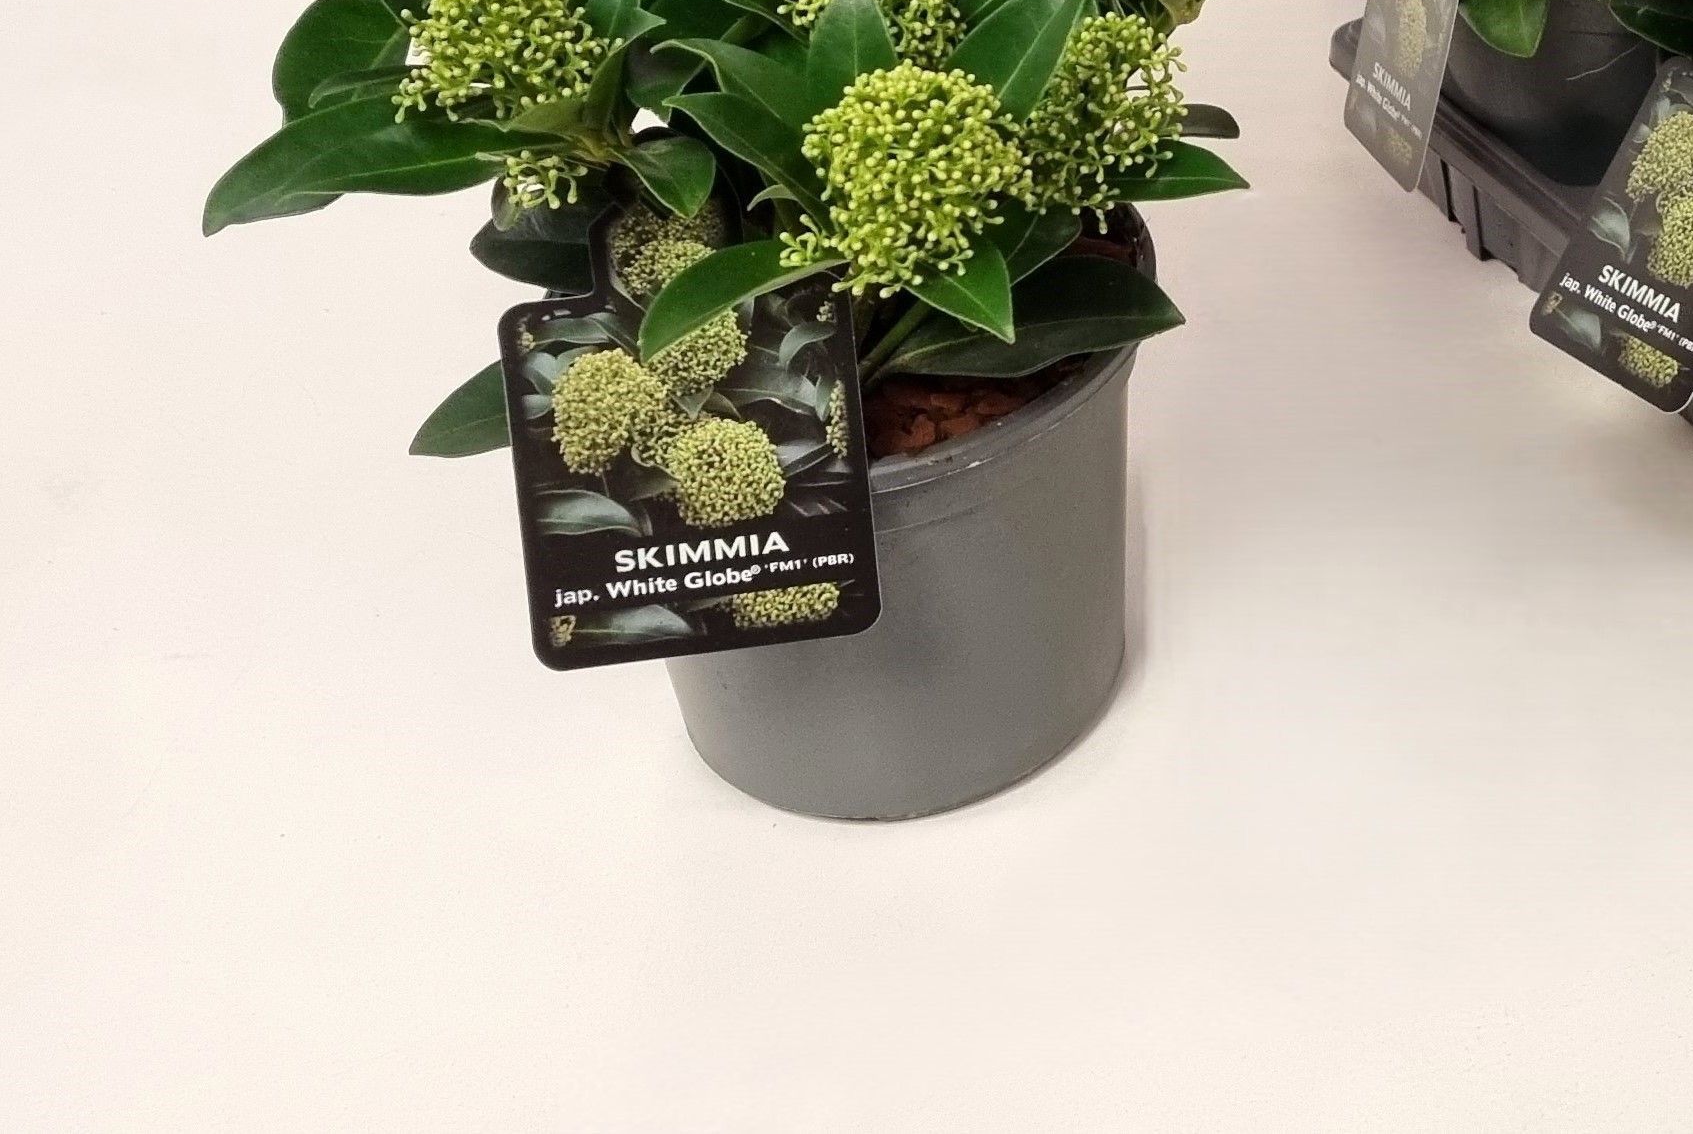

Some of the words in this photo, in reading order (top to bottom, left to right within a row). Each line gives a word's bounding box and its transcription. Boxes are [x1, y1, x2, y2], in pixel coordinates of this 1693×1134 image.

[1373, 62, 1411, 111] SKIMMIA
[1559, 272, 1581, 293] jap.
[1584, 284, 1616, 313] White
[1598, 265, 1681, 323] SKIMMIA
[614, 531, 790, 573] SKIMMIA
[555, 587, 600, 608] jap.
[605, 577, 678, 600] White
[812, 552, 855, 569] (PBR)
